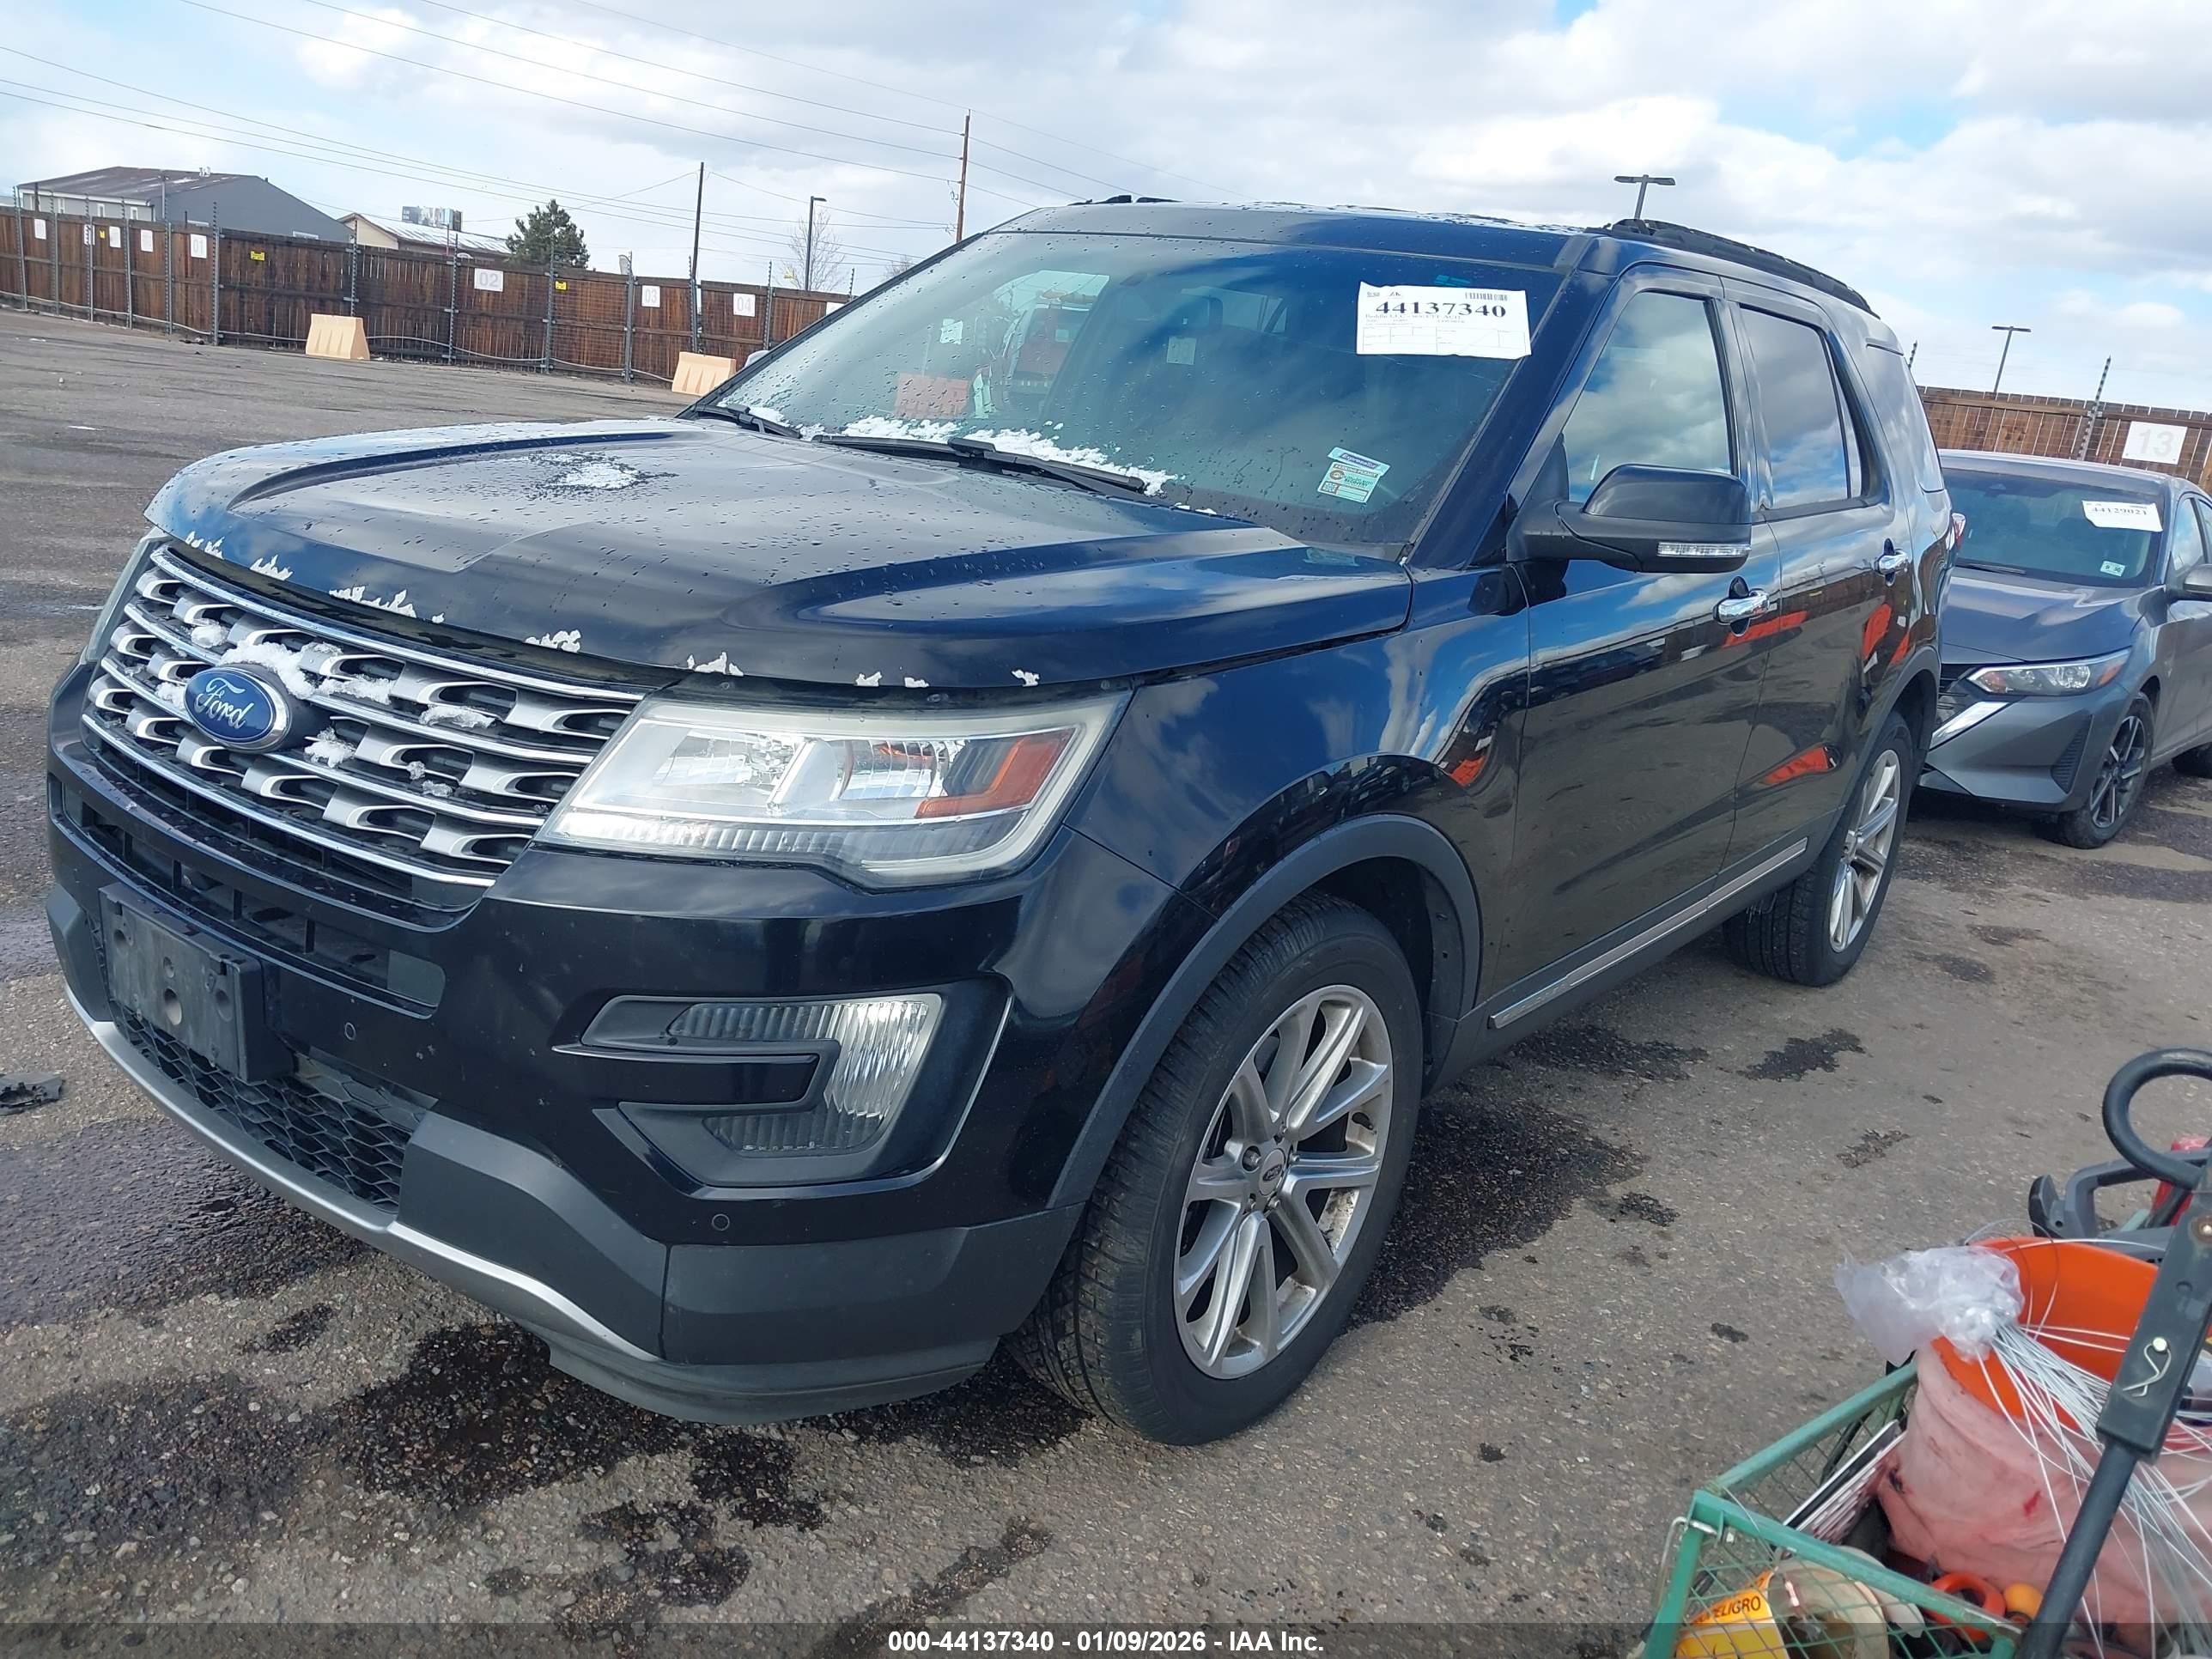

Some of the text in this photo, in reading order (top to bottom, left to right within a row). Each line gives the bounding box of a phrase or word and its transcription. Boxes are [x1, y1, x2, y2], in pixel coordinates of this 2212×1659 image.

[193, 239, 204, 254] 01
[479, 271, 498, 287] 02
[645, 289, 657, 303] 03
[737, 297, 750, 312] 04
[1376, 301, 1506, 317] 44137340
[2138, 428, 2174, 457] 13
[194, 678, 254, 729] Ford
